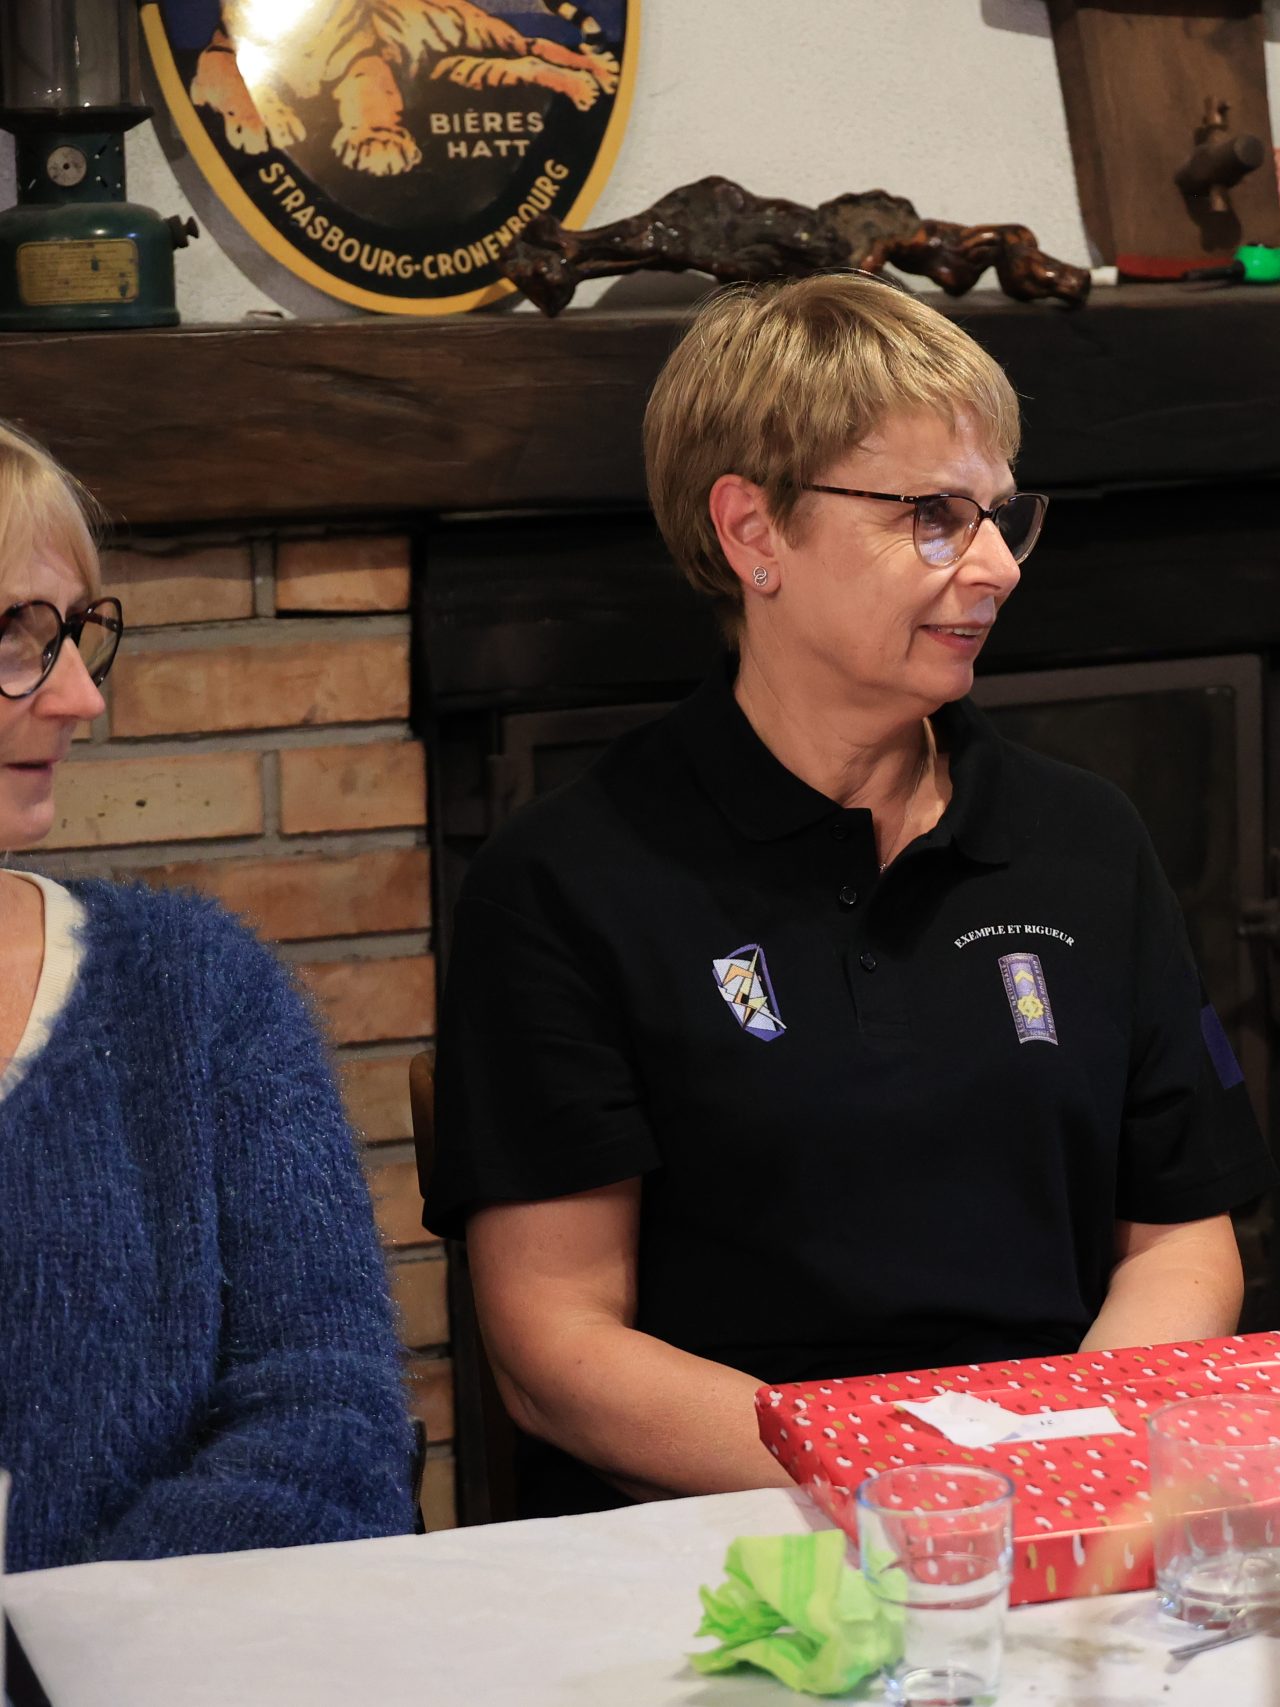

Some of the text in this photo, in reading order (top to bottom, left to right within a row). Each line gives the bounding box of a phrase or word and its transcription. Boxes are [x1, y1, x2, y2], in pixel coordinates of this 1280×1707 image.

[430, 107, 545, 134] BIÈRES
[447, 138, 531, 159] HATT
[953, 924, 1075, 949] EXEMPLE ET RIGUEUR
